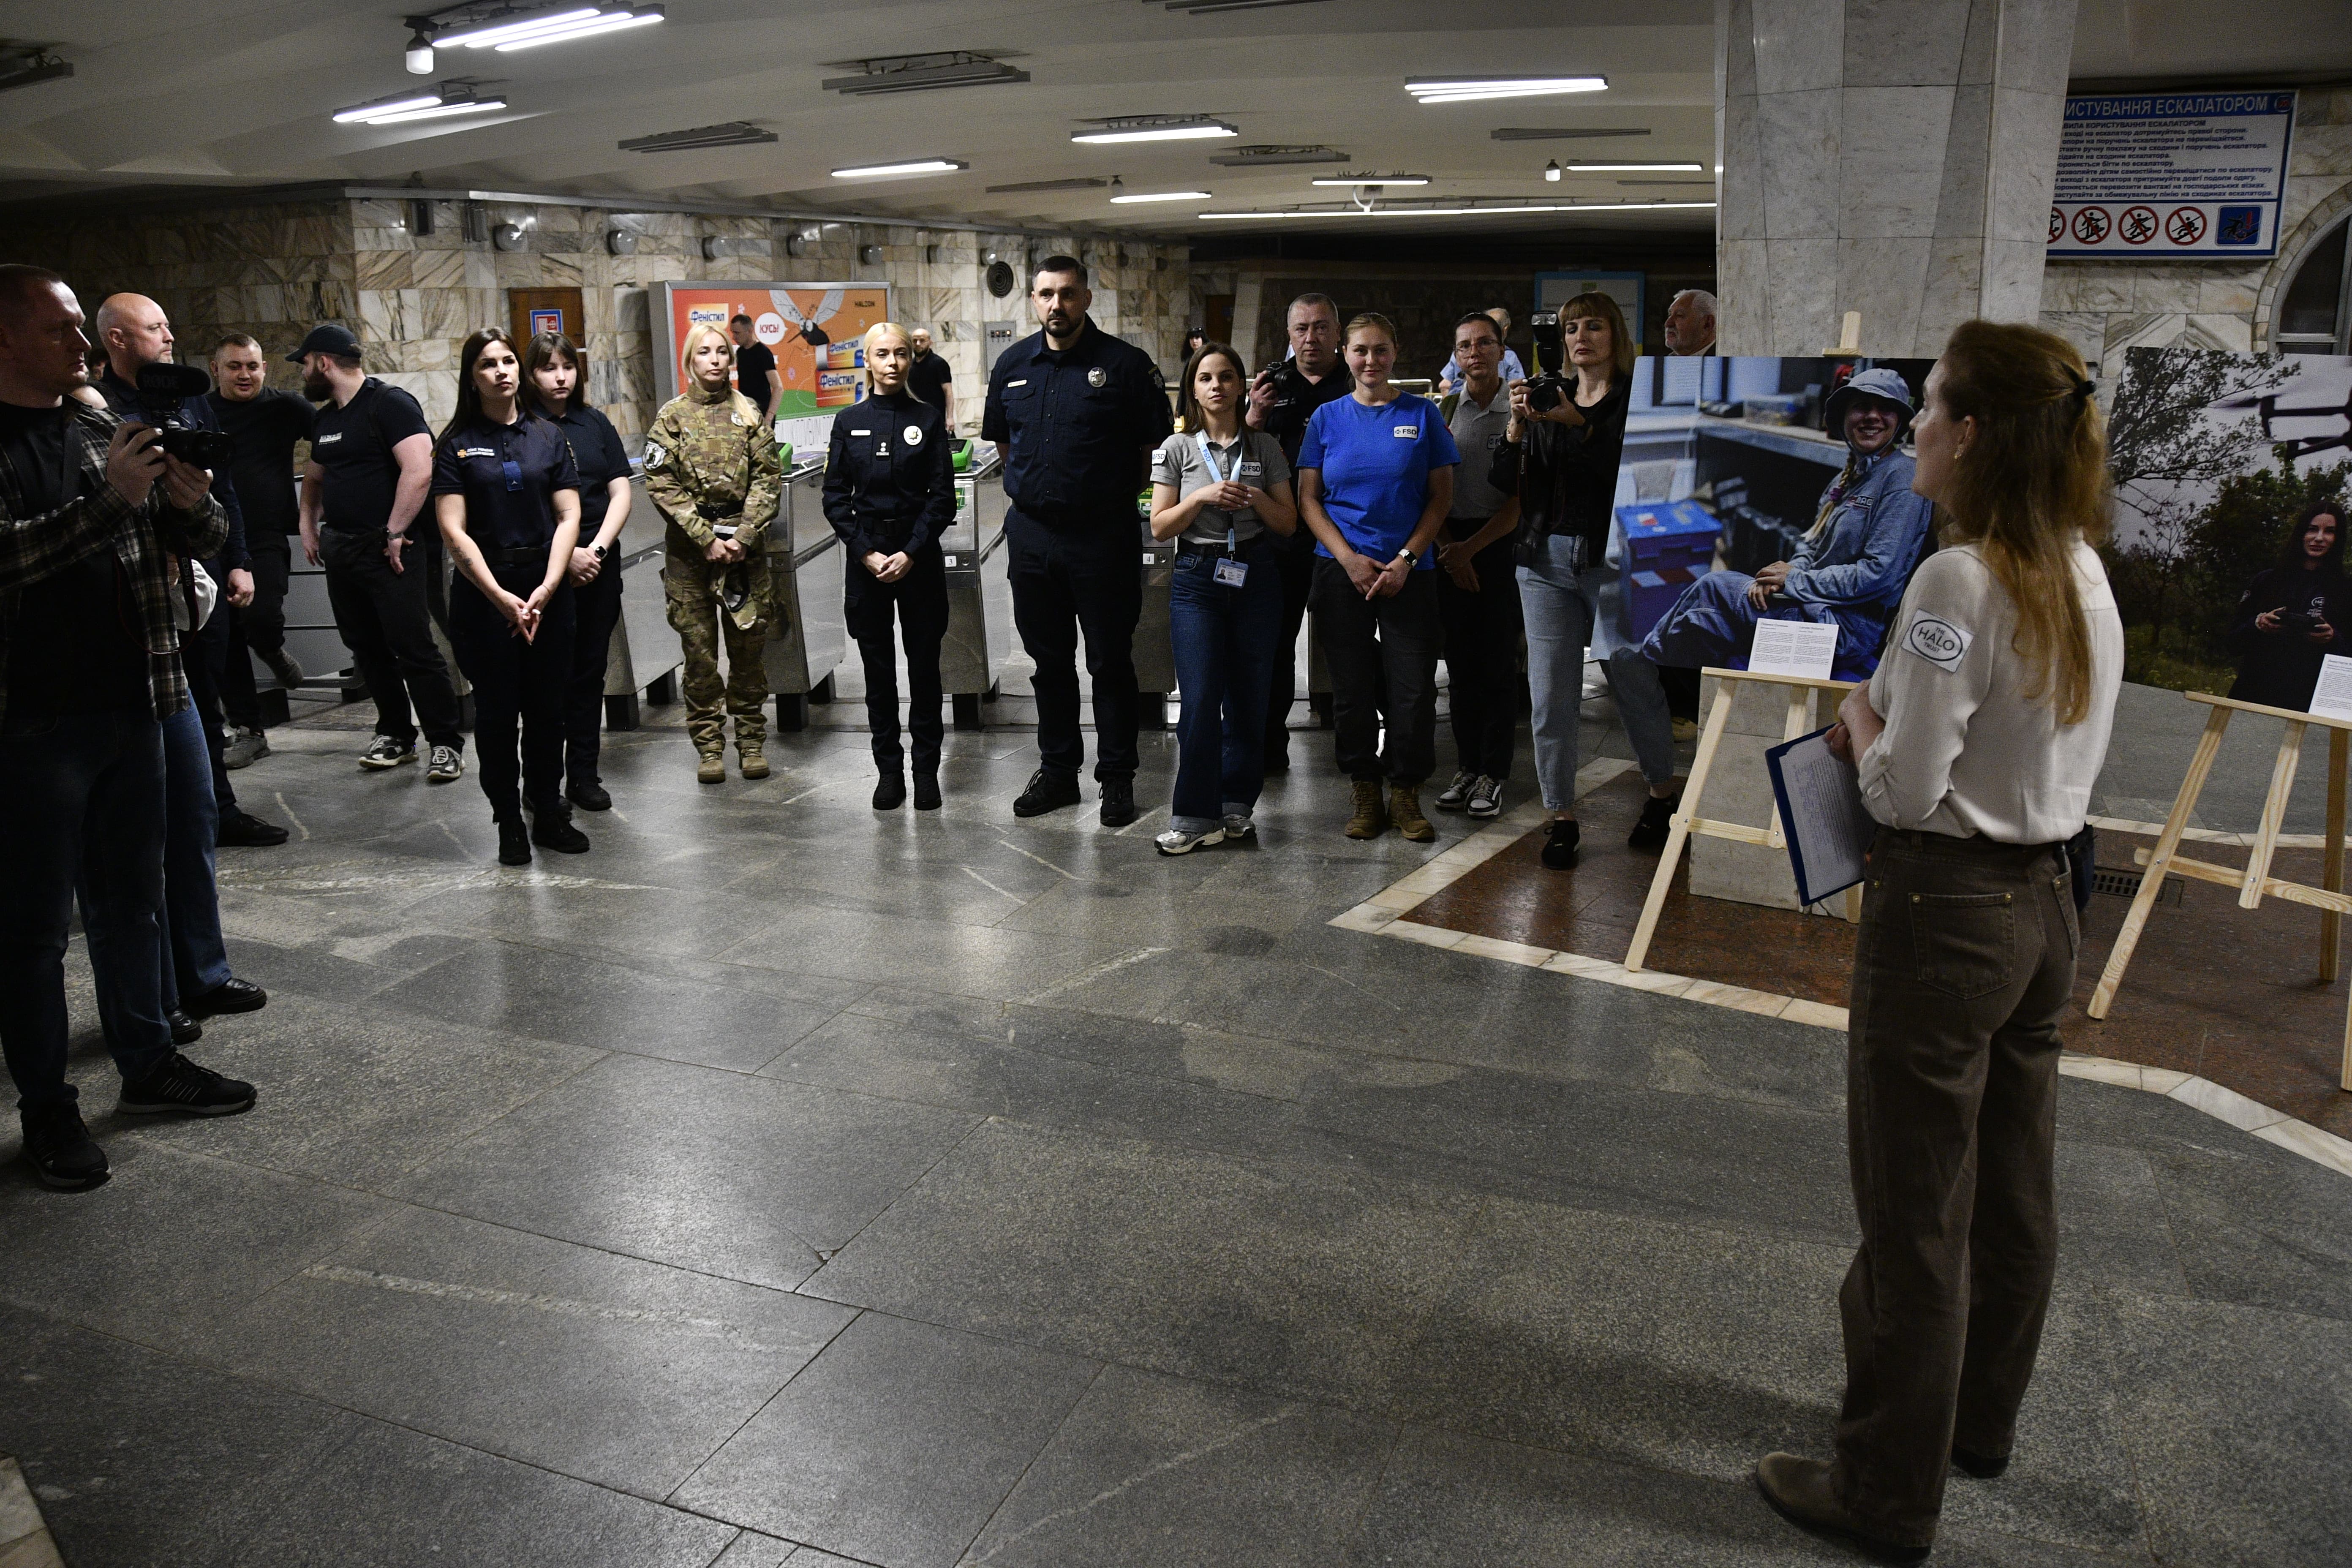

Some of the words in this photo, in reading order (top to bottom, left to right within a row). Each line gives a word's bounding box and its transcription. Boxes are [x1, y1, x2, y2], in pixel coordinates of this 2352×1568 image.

[2066, 101, 2151, 116] ИСТУВАННЯ
[2156, 97, 2268, 114] ЕСКАЛАТОРОМ
[690, 310, 724, 323] Феністил
[760, 324, 779, 333] КУСЬ!
[829, 339, 858, 354] Феністил
[819, 373, 855, 388] Феністил
[1402, 428, 1417, 436] FSD
[1203, 449, 1211, 462] FSD
[1936, 627, 1946, 635] THE
[1918, 627, 1955, 651] HALO
[1924, 642, 1941, 653] TRUST
